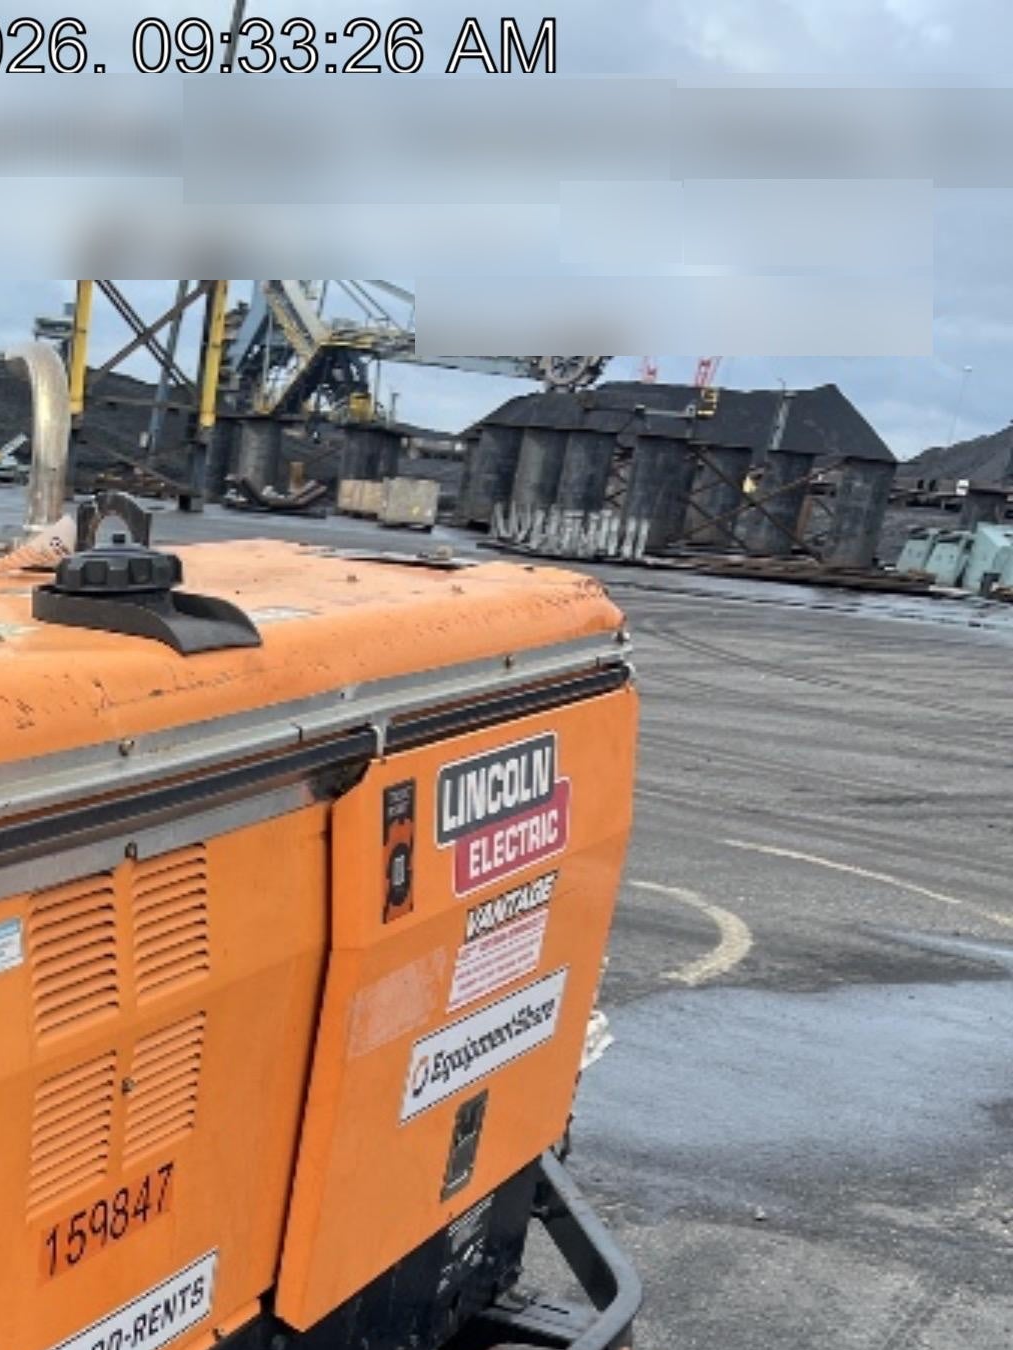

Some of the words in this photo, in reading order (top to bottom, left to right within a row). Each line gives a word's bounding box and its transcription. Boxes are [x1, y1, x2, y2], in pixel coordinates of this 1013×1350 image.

[442, 747, 552, 832] LINCOLN
[469, 809, 559, 879] ELECTRIC
[466, 871, 557, 939] VANTAGE
[46, 1162, 174, 1276] 159847
